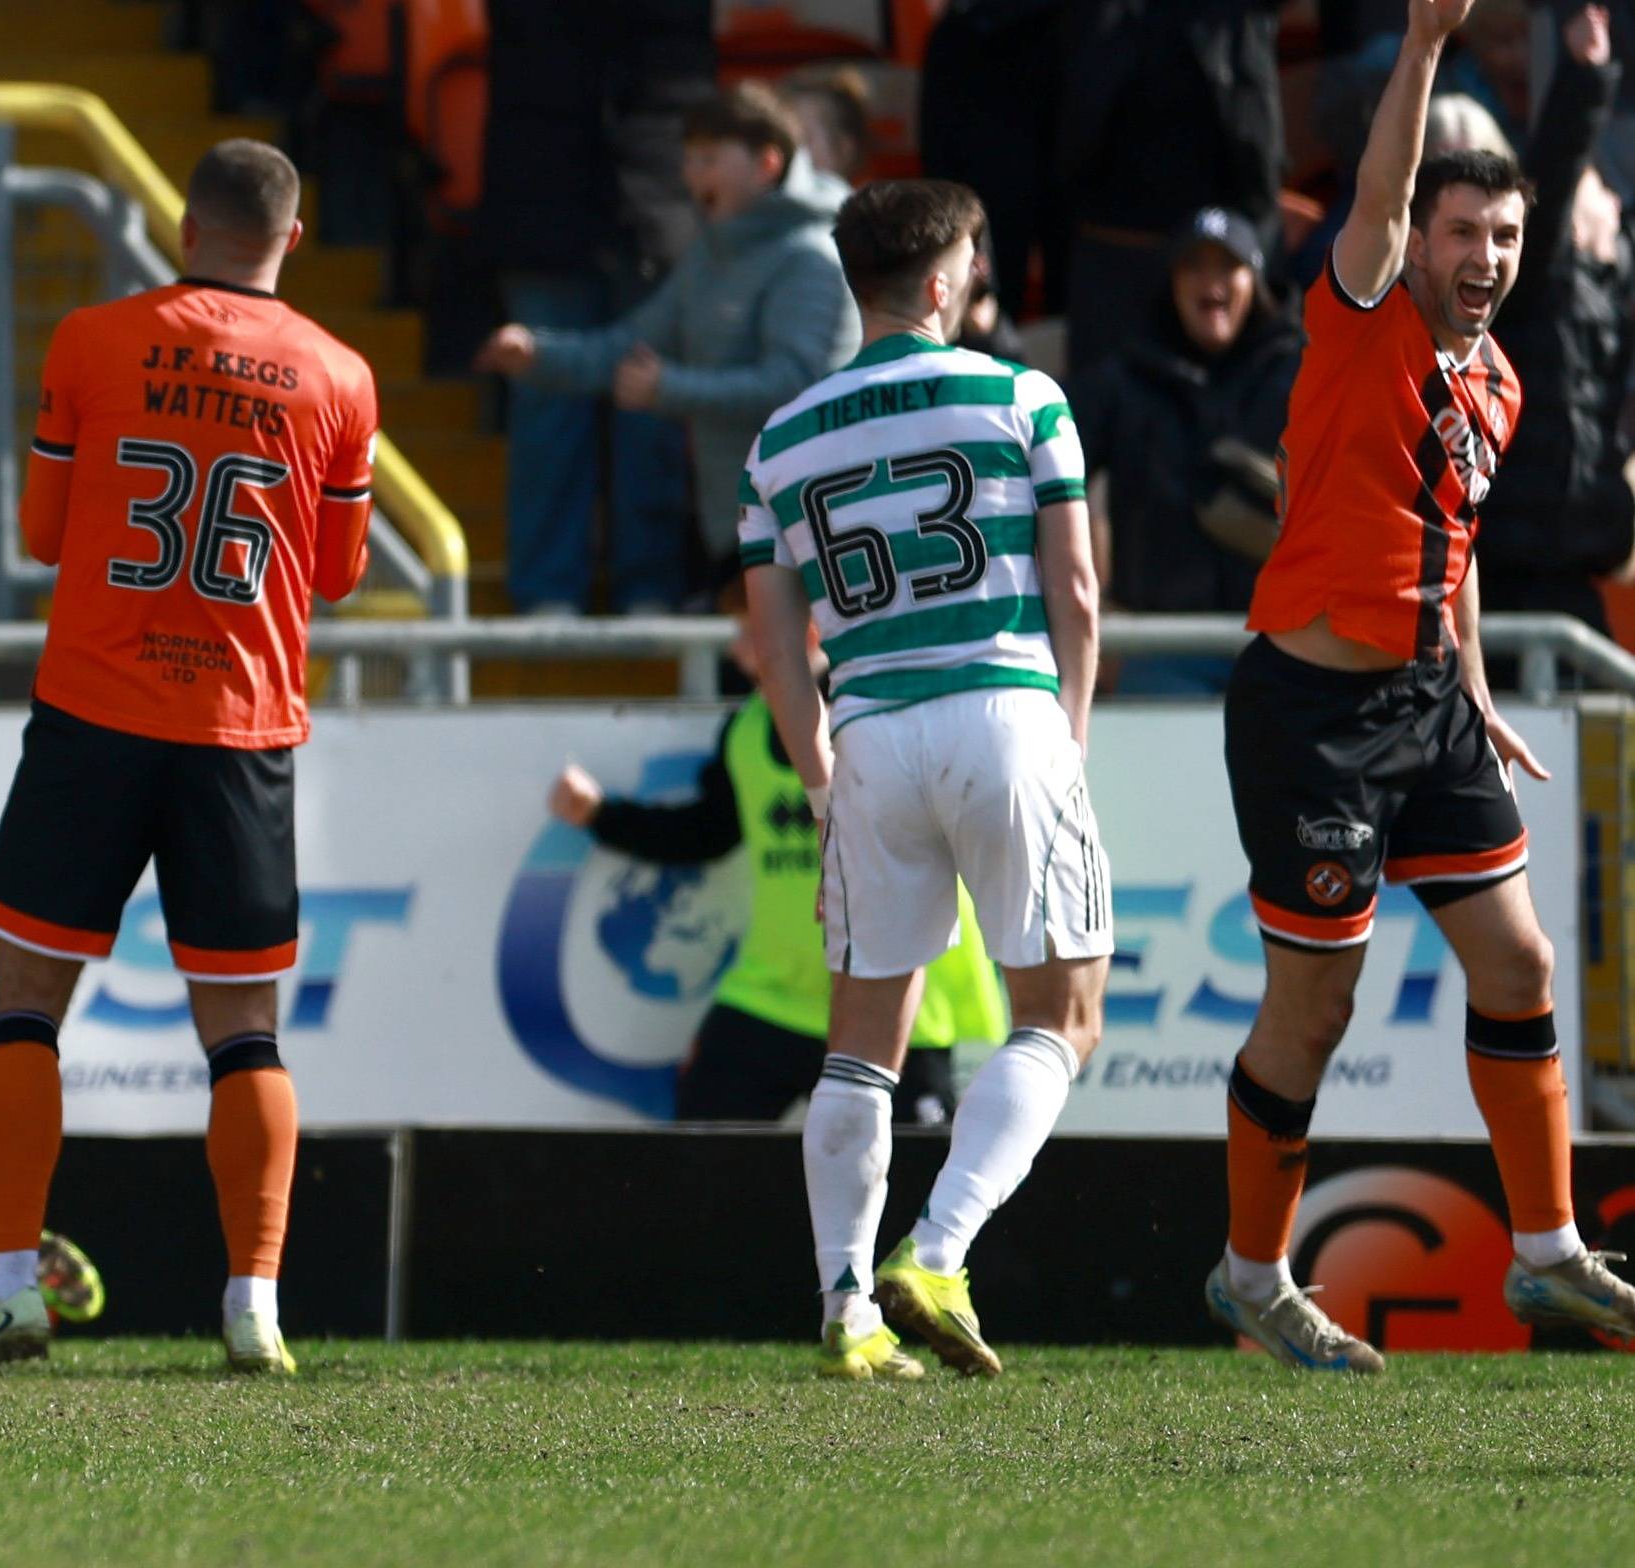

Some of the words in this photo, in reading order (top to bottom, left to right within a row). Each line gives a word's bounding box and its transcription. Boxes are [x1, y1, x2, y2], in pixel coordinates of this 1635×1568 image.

[142, 345, 198, 371] J.F.
[211, 350, 298, 390] KEGS
[143, 380, 287, 436] WATTERS
[814, 379, 946, 433] TIERNEY
[107, 438, 293, 606] 36
[799, 446, 989, 620] 63
[136, 648, 233, 672] JAMIESON
[142, 632, 229, 656] NORMAN
[161, 665, 197, 684] LTD
